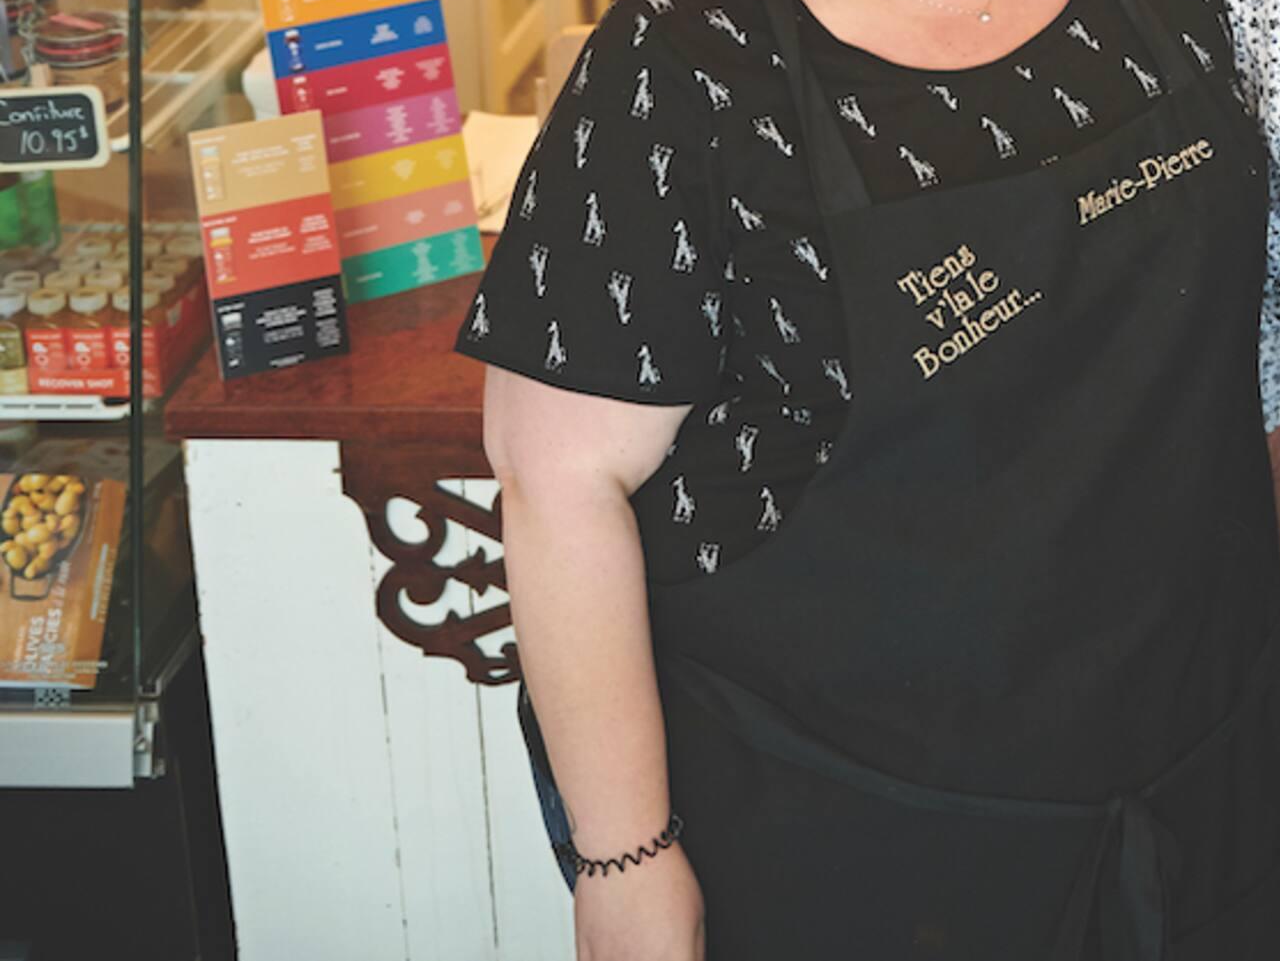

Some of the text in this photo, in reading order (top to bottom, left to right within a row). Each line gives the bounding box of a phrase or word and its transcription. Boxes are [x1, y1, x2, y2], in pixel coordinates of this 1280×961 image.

[1077, 138, 1214, 226] Marie-Pierre
[897, 244, 977, 307] Tiens
[912, 288, 1043, 380] Bonheur...
[38, 378, 114, 389] RECOVER SHOT
